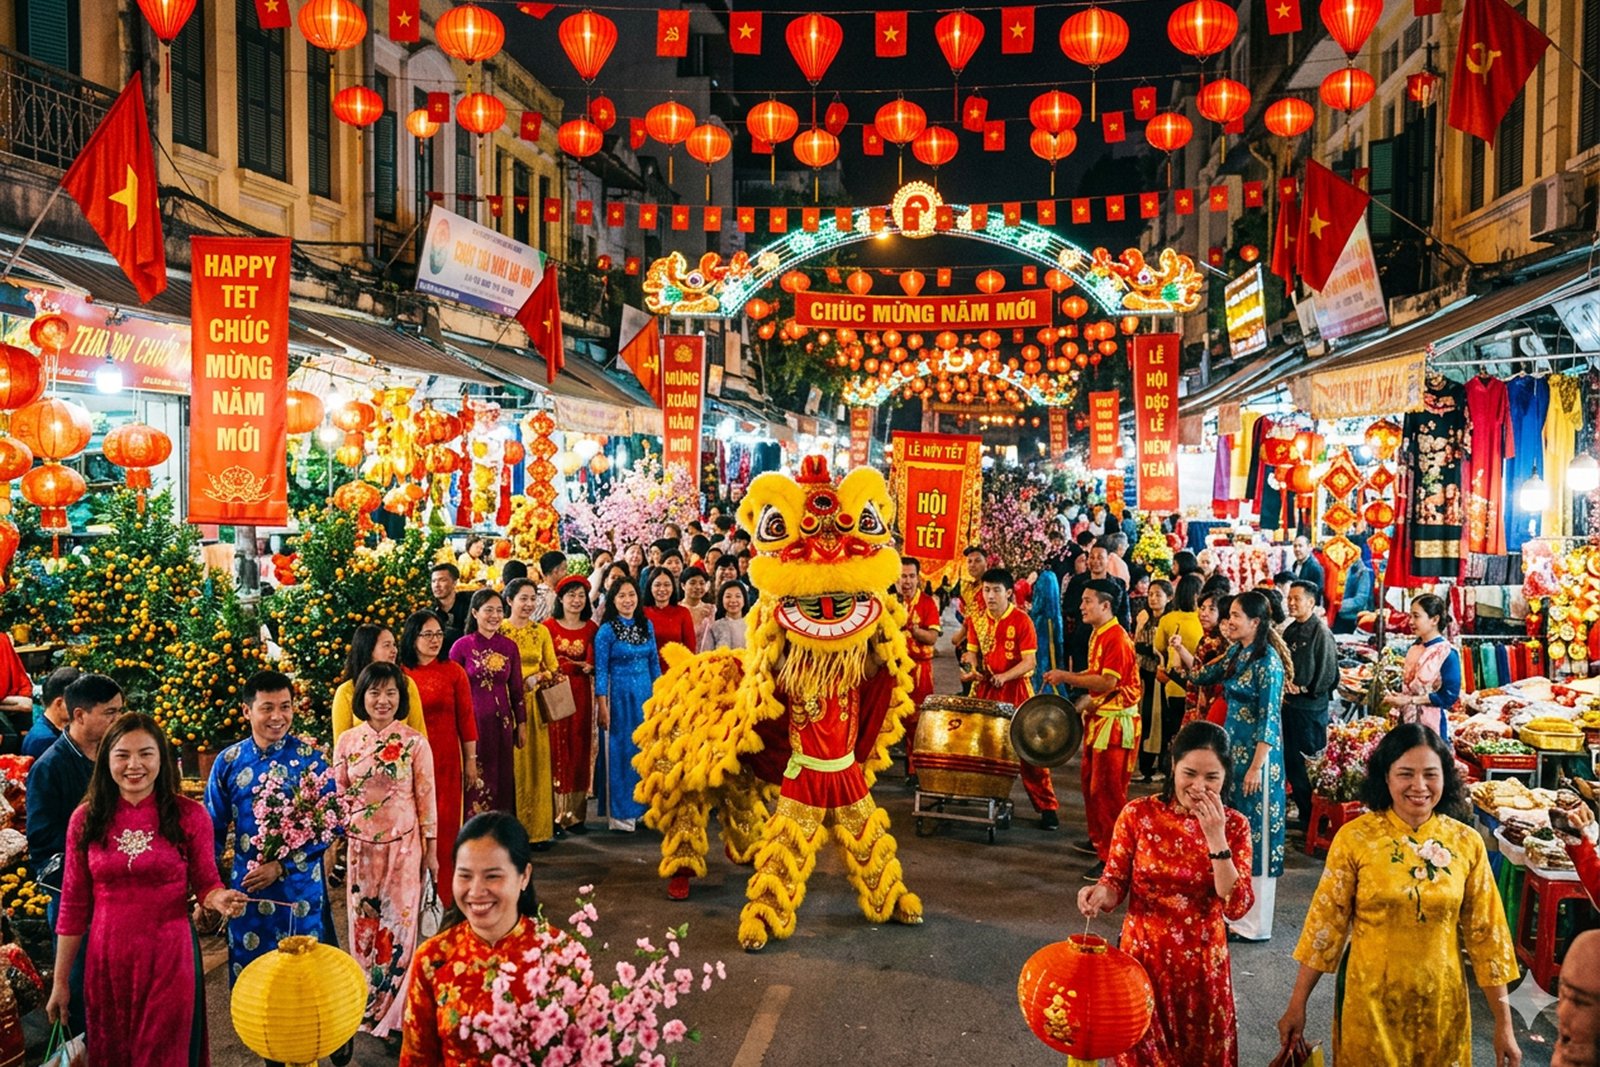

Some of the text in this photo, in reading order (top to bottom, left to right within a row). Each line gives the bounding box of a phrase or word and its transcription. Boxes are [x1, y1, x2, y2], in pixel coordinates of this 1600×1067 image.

[204, 254, 276, 278] HAPPY
[221, 285, 259, 308] TET
[872, 300, 934, 323] MỪNG
[996, 296, 1036, 321] MỚI
[209, 314, 270, 344] CHÚC
[205, 349, 273, 380] MỪNG
[212, 386, 265, 416] NĂM
[217, 421, 260, 452] MỚI
[917, 489, 947, 519] HỘI
